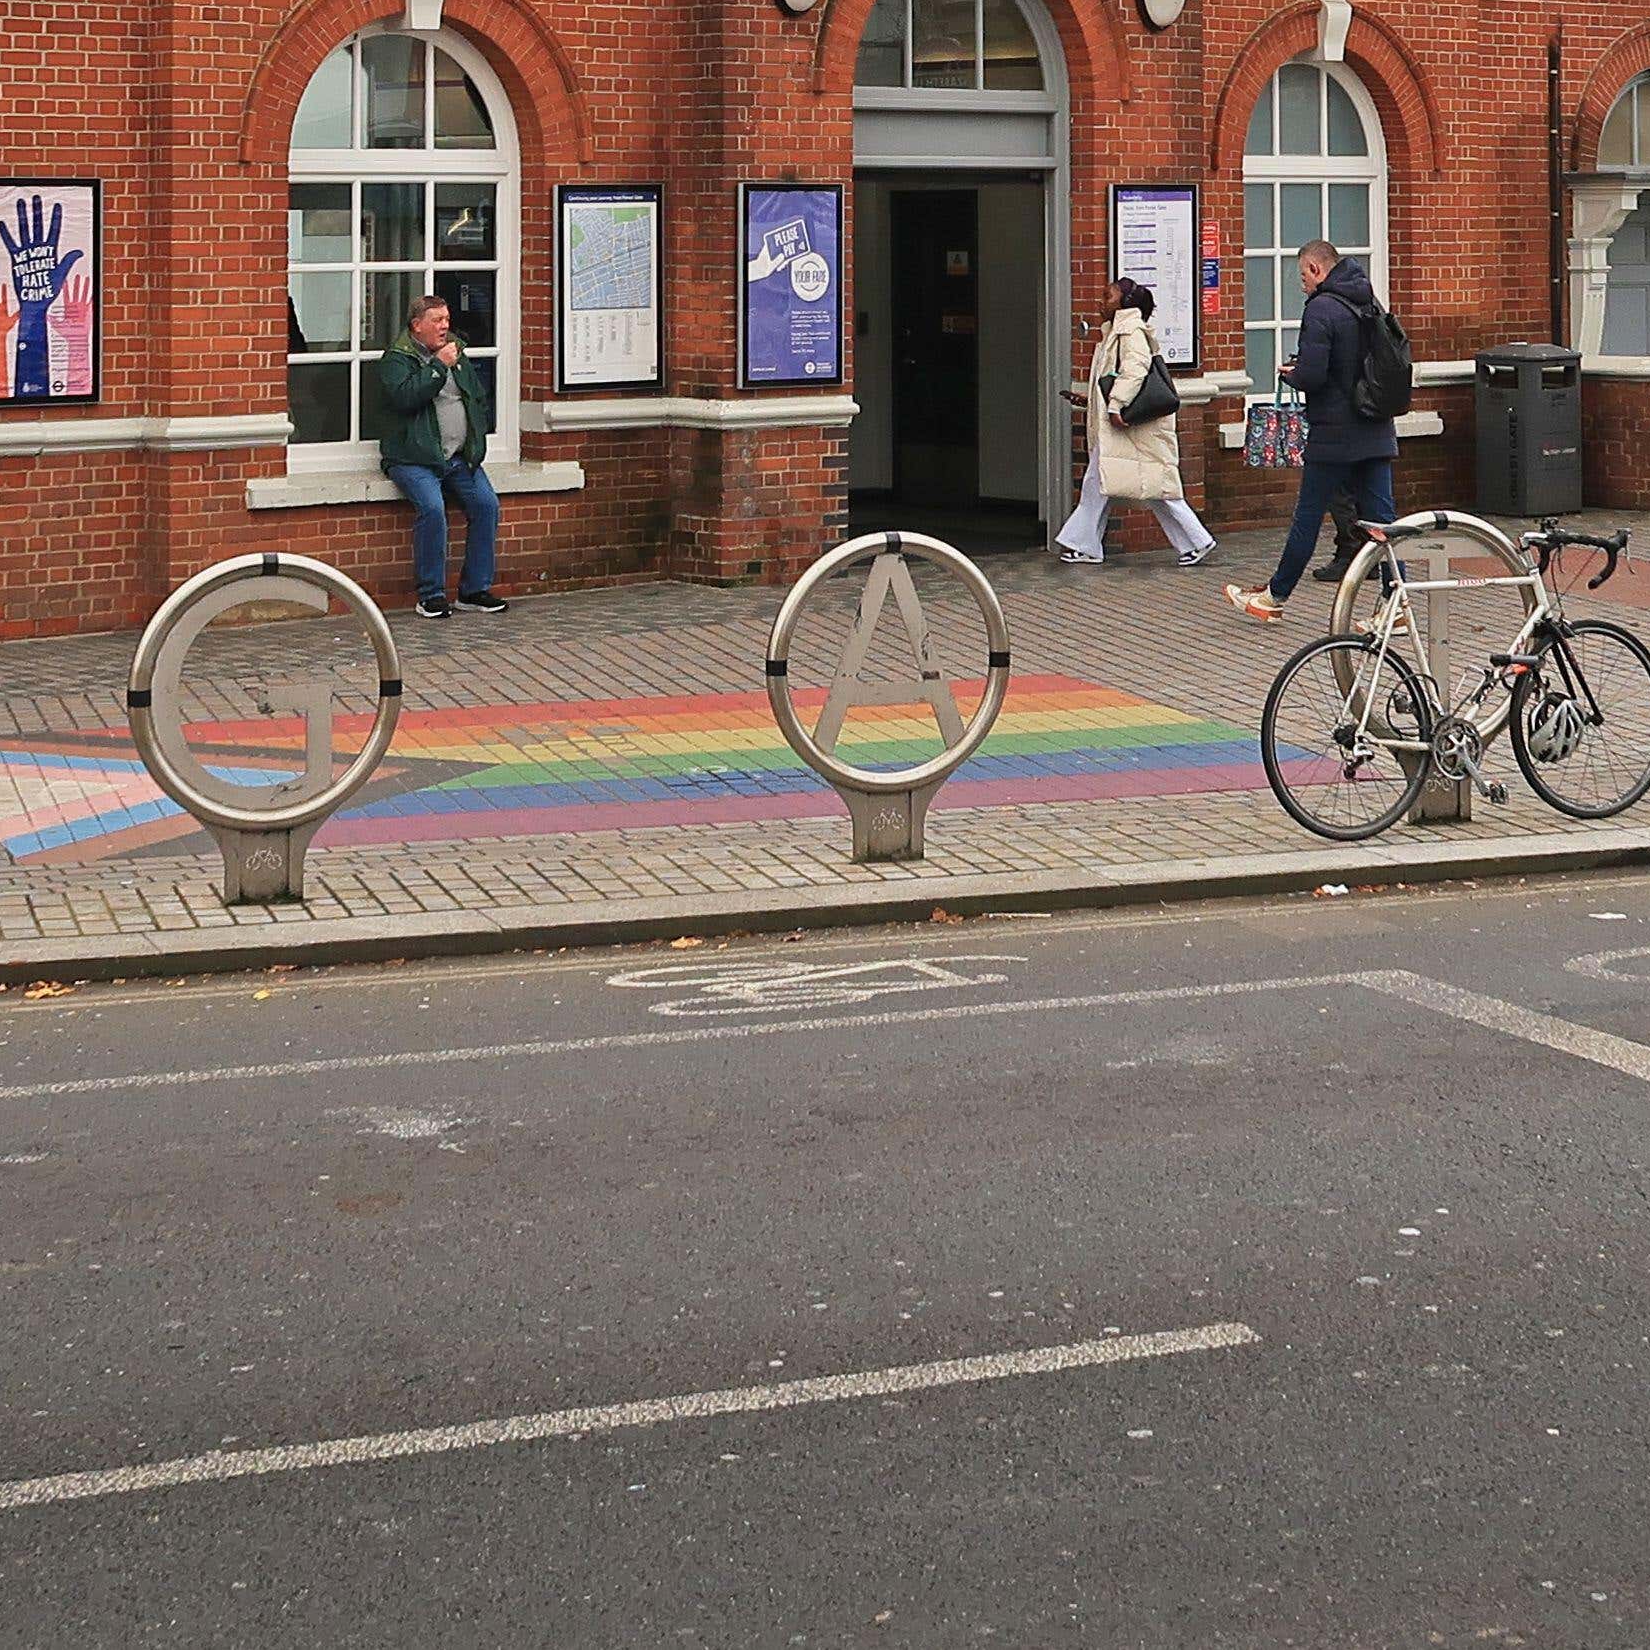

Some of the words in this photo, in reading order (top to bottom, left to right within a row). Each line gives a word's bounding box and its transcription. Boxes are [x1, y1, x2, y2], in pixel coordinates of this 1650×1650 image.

[774, 226, 800, 247] PLEASE
[13, 250, 28, 263] WE
[783, 242, 796, 258] PAY
[13, 257, 56, 277] TOLERATE
[21, 270, 51, 287] HATE
[794, 270, 810, 283] YOUR
[20, 284, 55, 301] CRIME
